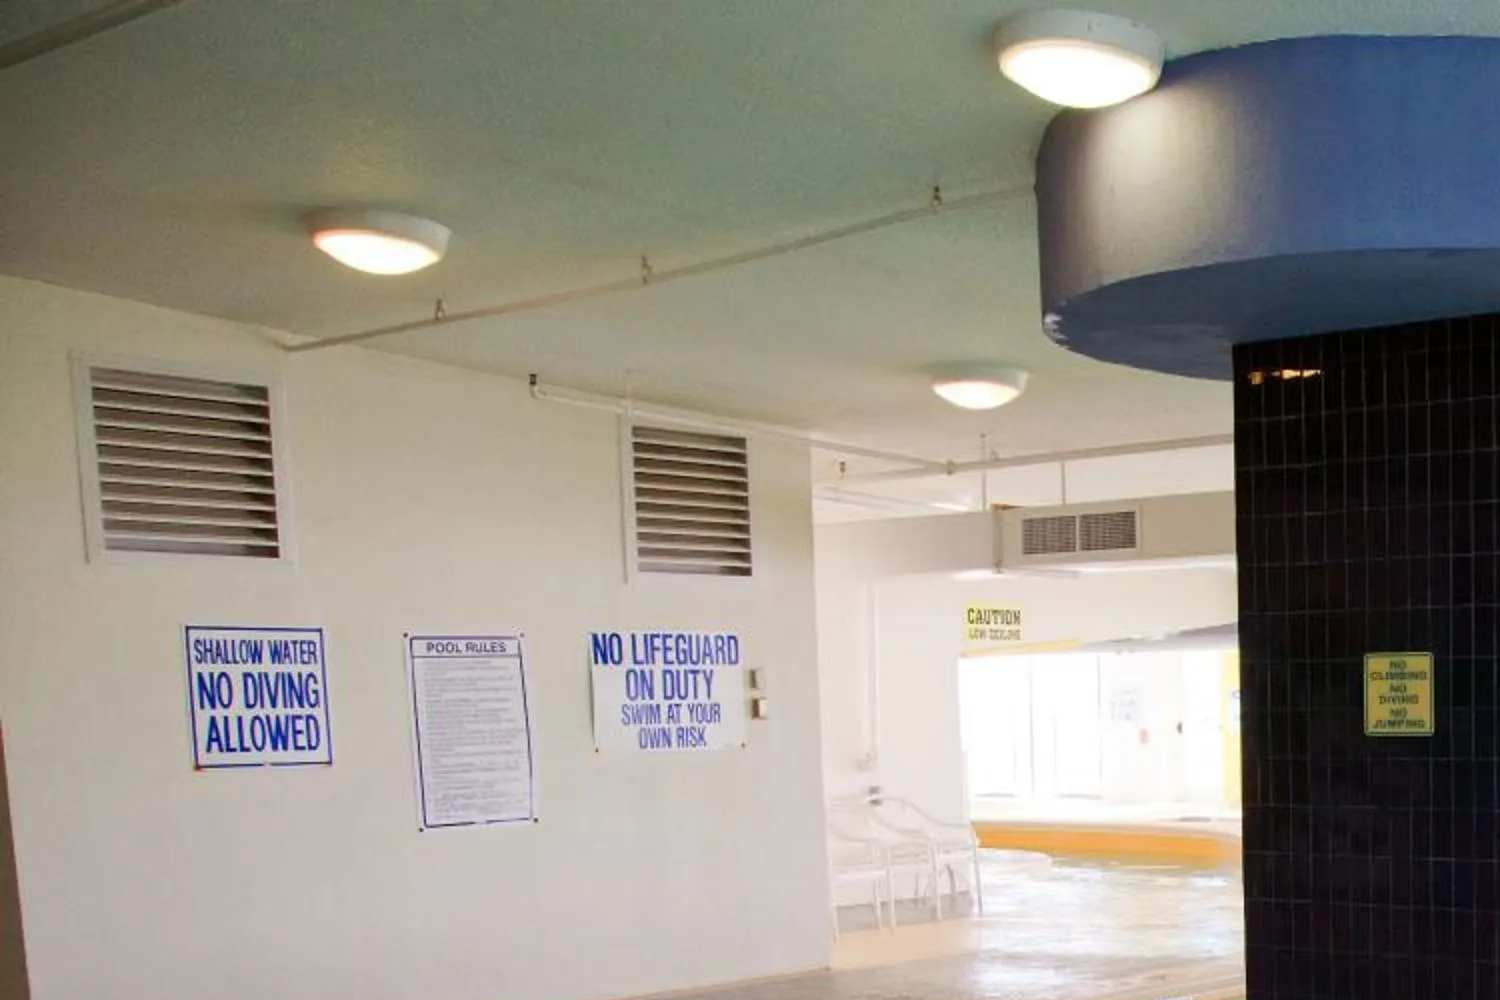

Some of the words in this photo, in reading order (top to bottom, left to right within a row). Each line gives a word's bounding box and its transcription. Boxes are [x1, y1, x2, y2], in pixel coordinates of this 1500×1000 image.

[967, 608, 1021, 624] CAUTION
[193, 639, 263, 665] SHALLOW
[267, 639, 318, 665] WATER
[426, 641, 462, 653] POOL
[465, 641, 507, 653] RULES
[591, 633, 623, 665] NO
[631, 634, 739, 665] LIFEGUARD
[197, 671, 233, 710] NO
[242, 671, 320, 709] DIVING
[625, 669, 654, 700] ON
[662, 669, 714, 700] DUTY
[621, 703, 661, 725] SWIM
[667, 703, 682, 724] AT
[687, 703, 721, 724] YOUR
[206, 714, 320, 752] ALLOWED
[639, 726, 672, 749] OWN
[676, 725, 707, 747] RISK
